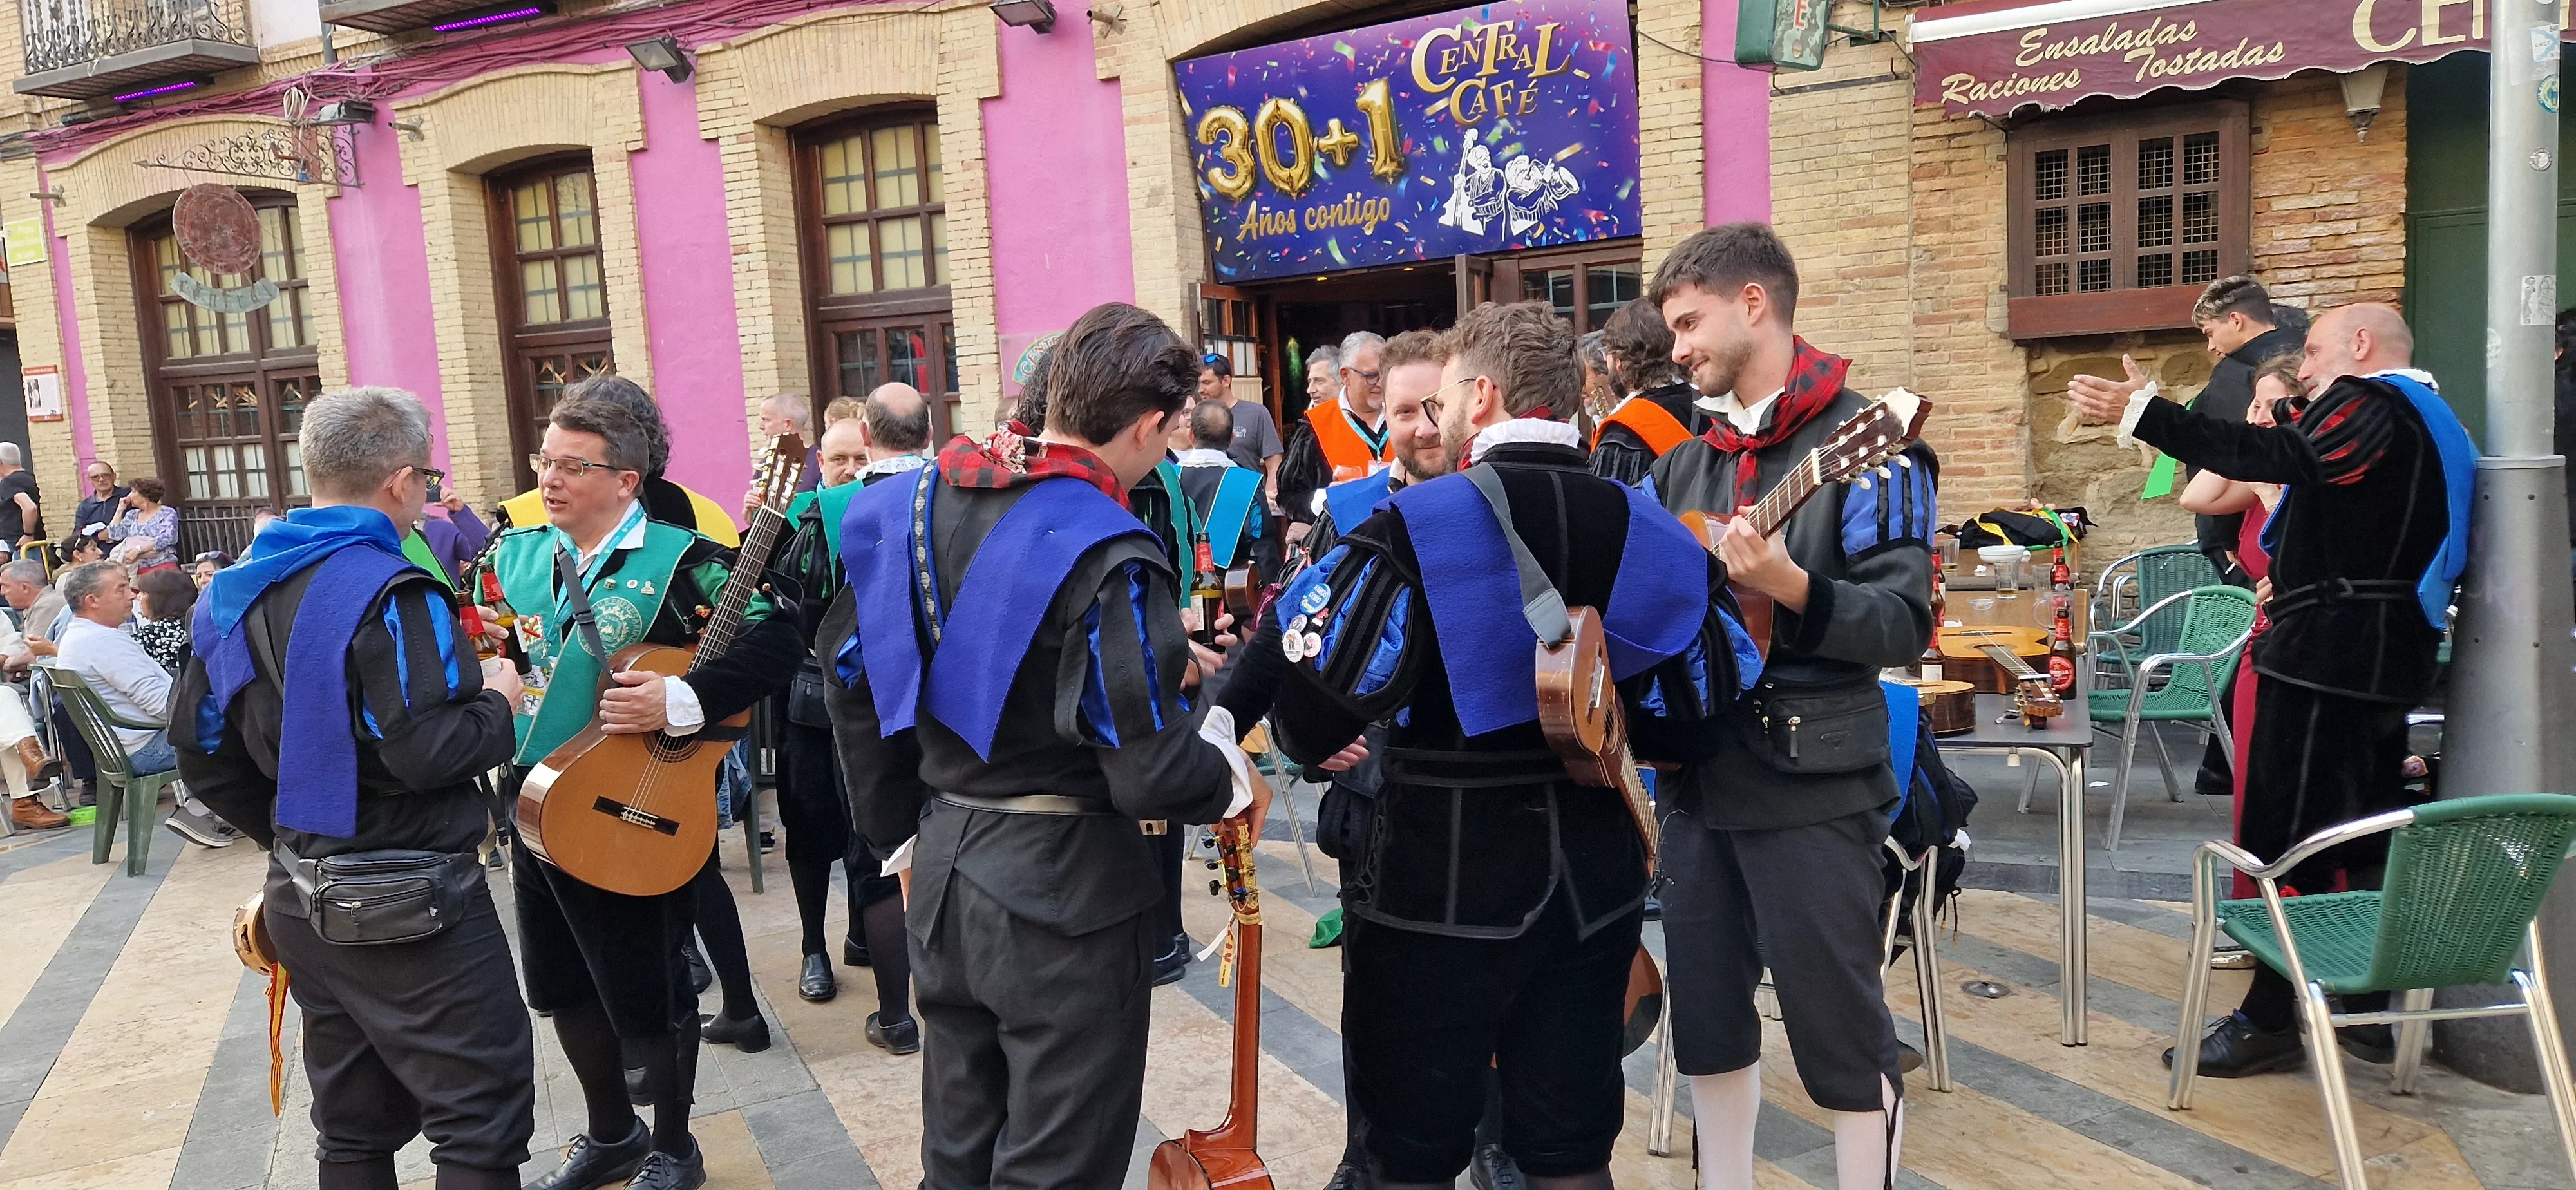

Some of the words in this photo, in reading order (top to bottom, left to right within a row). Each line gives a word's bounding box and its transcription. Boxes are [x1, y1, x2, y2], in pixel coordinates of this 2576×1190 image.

[1411, 20, 1571, 93] CENTRAL
[1941, 68, 2082, 105] Raciones
[2123, 37, 2286, 82] Tostadas
[2015, 16, 2198, 67] Ensaladas
[1450, 77, 1539, 126] CAFÉ
[1198, 77, 1404, 202] 30+1
[1236, 200, 1296, 241] Años
[1305, 191, 1390, 236] contigo
